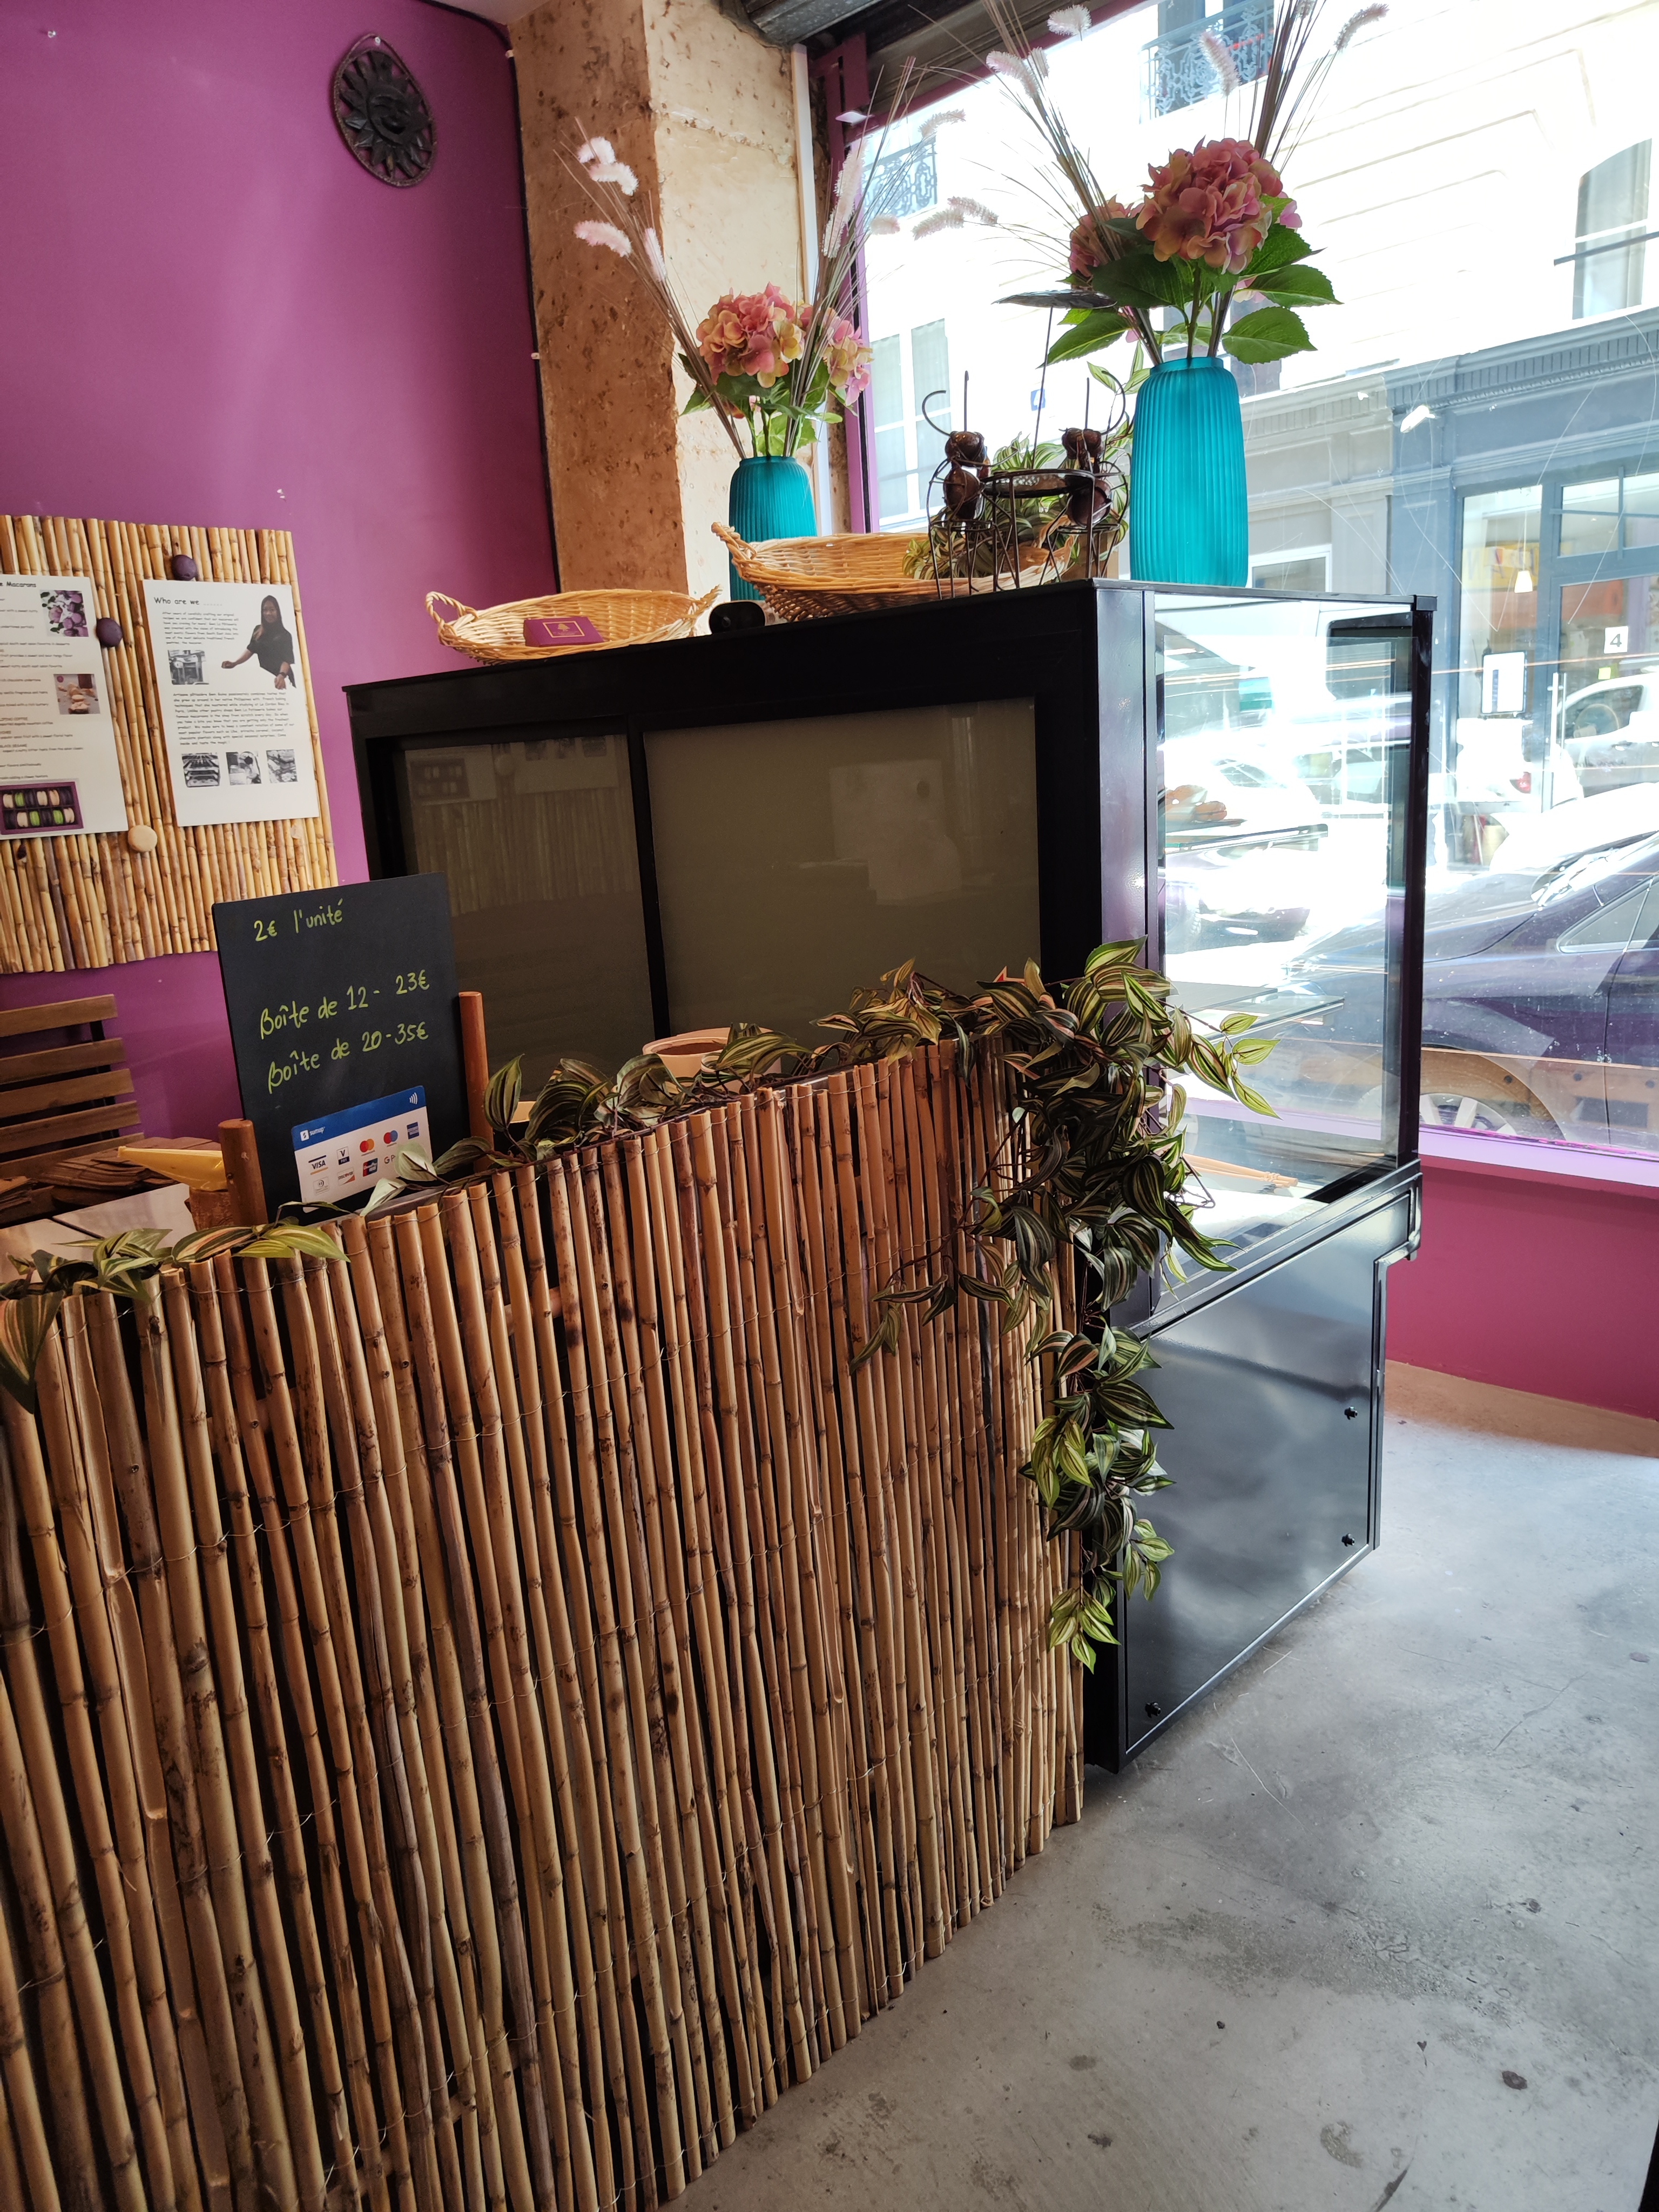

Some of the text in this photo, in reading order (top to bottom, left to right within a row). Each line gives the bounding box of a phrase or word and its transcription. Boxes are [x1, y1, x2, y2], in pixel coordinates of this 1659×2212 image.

[1609, 633, 1622, 648] 4
[254, 898, 343, 942] 2€ l'unité
[260, 1000, 309, 1040] Boîte
[318, 996, 338, 1019] de
[395, 969, 430, 995] 23€
[268, 1050, 321, 1095] Boîte
[331, 1038, 350, 1060] de
[311, 1159, 326, 1170] VISA
